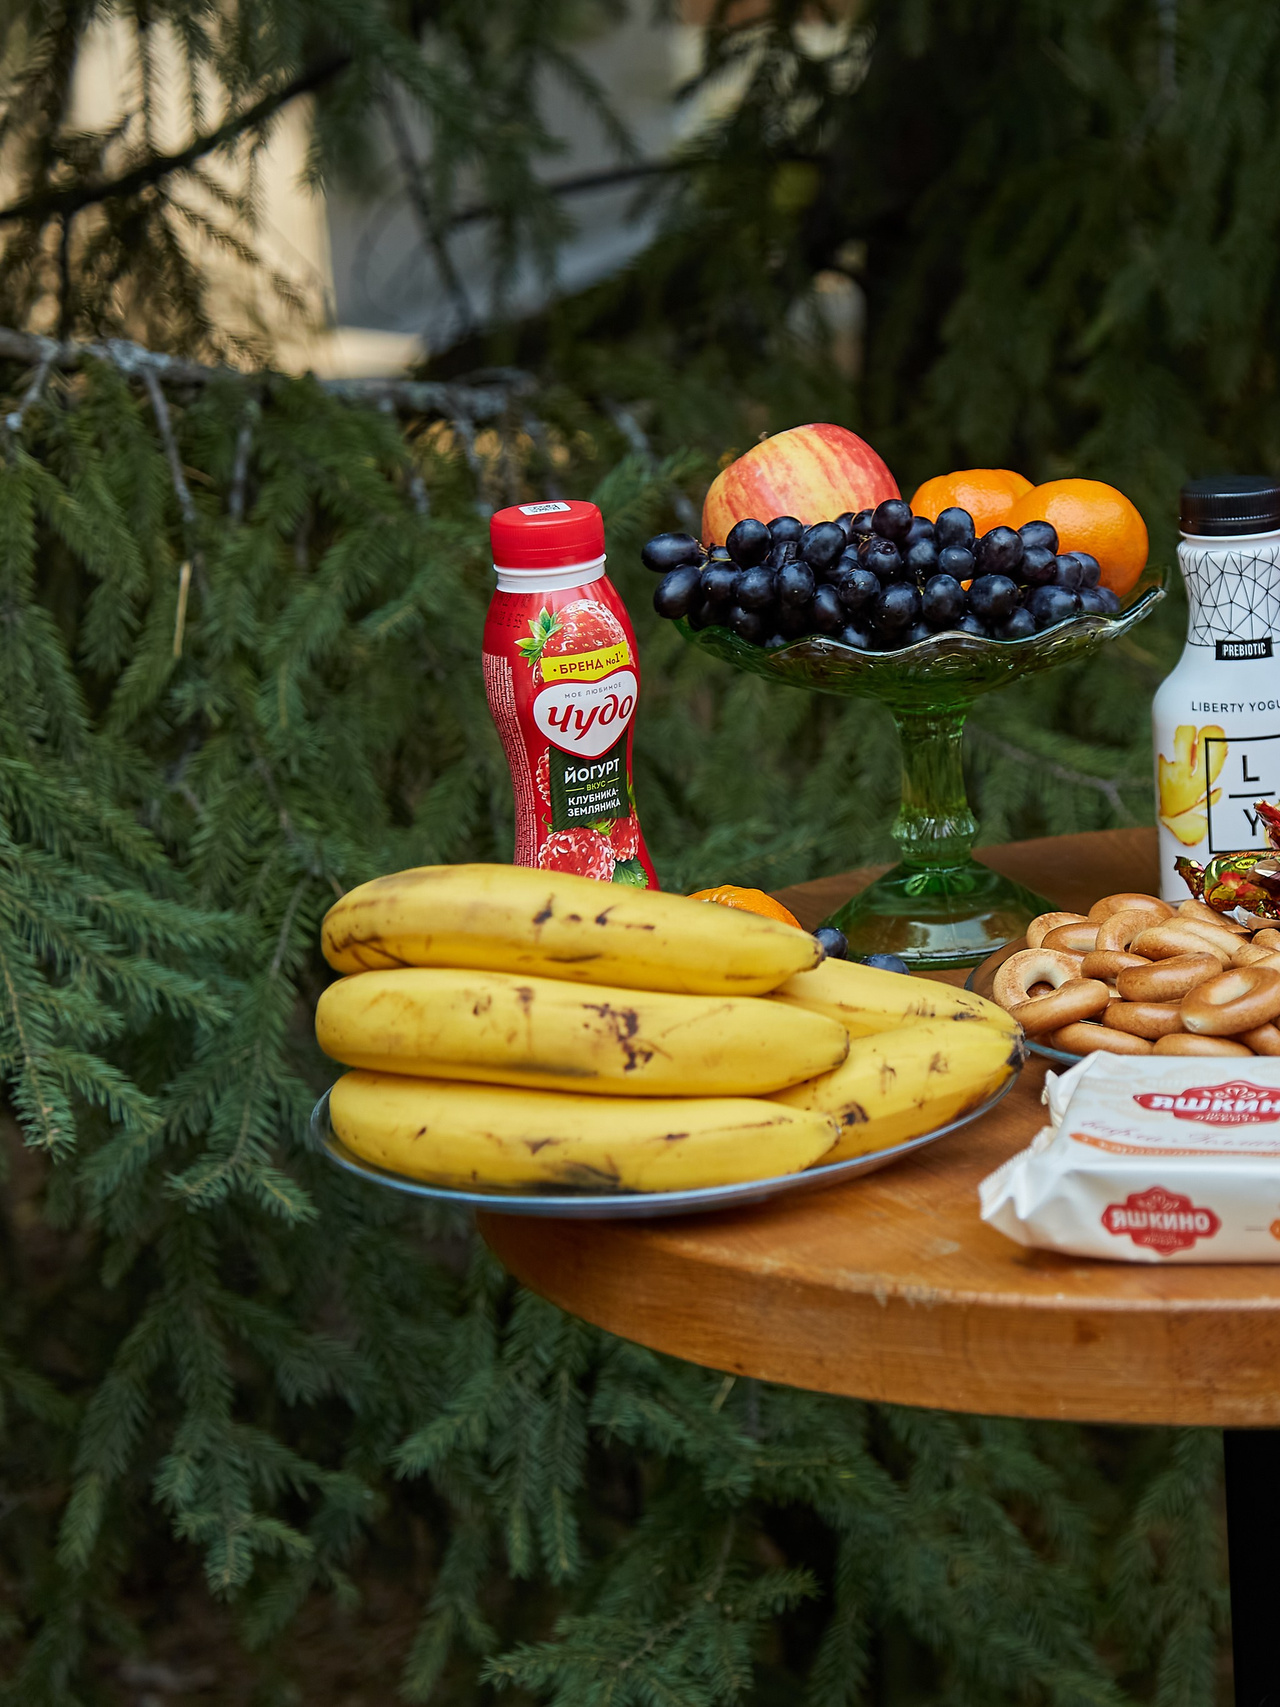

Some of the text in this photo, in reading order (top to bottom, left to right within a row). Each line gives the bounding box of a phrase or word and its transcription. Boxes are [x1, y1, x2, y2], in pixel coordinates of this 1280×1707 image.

[1223, 642, 1267, 657] PREBIOTIC
[559, 659, 604, 674] БРЕНД
[564, 682, 622, 699] МОЕ ЛЮБИМОЕ
[1191, 701, 1244, 713] LIBERTY
[548, 694, 633, 741] Чудо
[564, 758, 620, 784] ЙОГУРТ
[1242, 755, 1260, 782] L
[586, 781, 606, 791] ВКУС
[567, 798, 621, 817] ЗЕМЛЯНИКА
[1243, 808, 1262, 837] Y
[1111, 1208, 1210, 1231] ЯШКИНО
